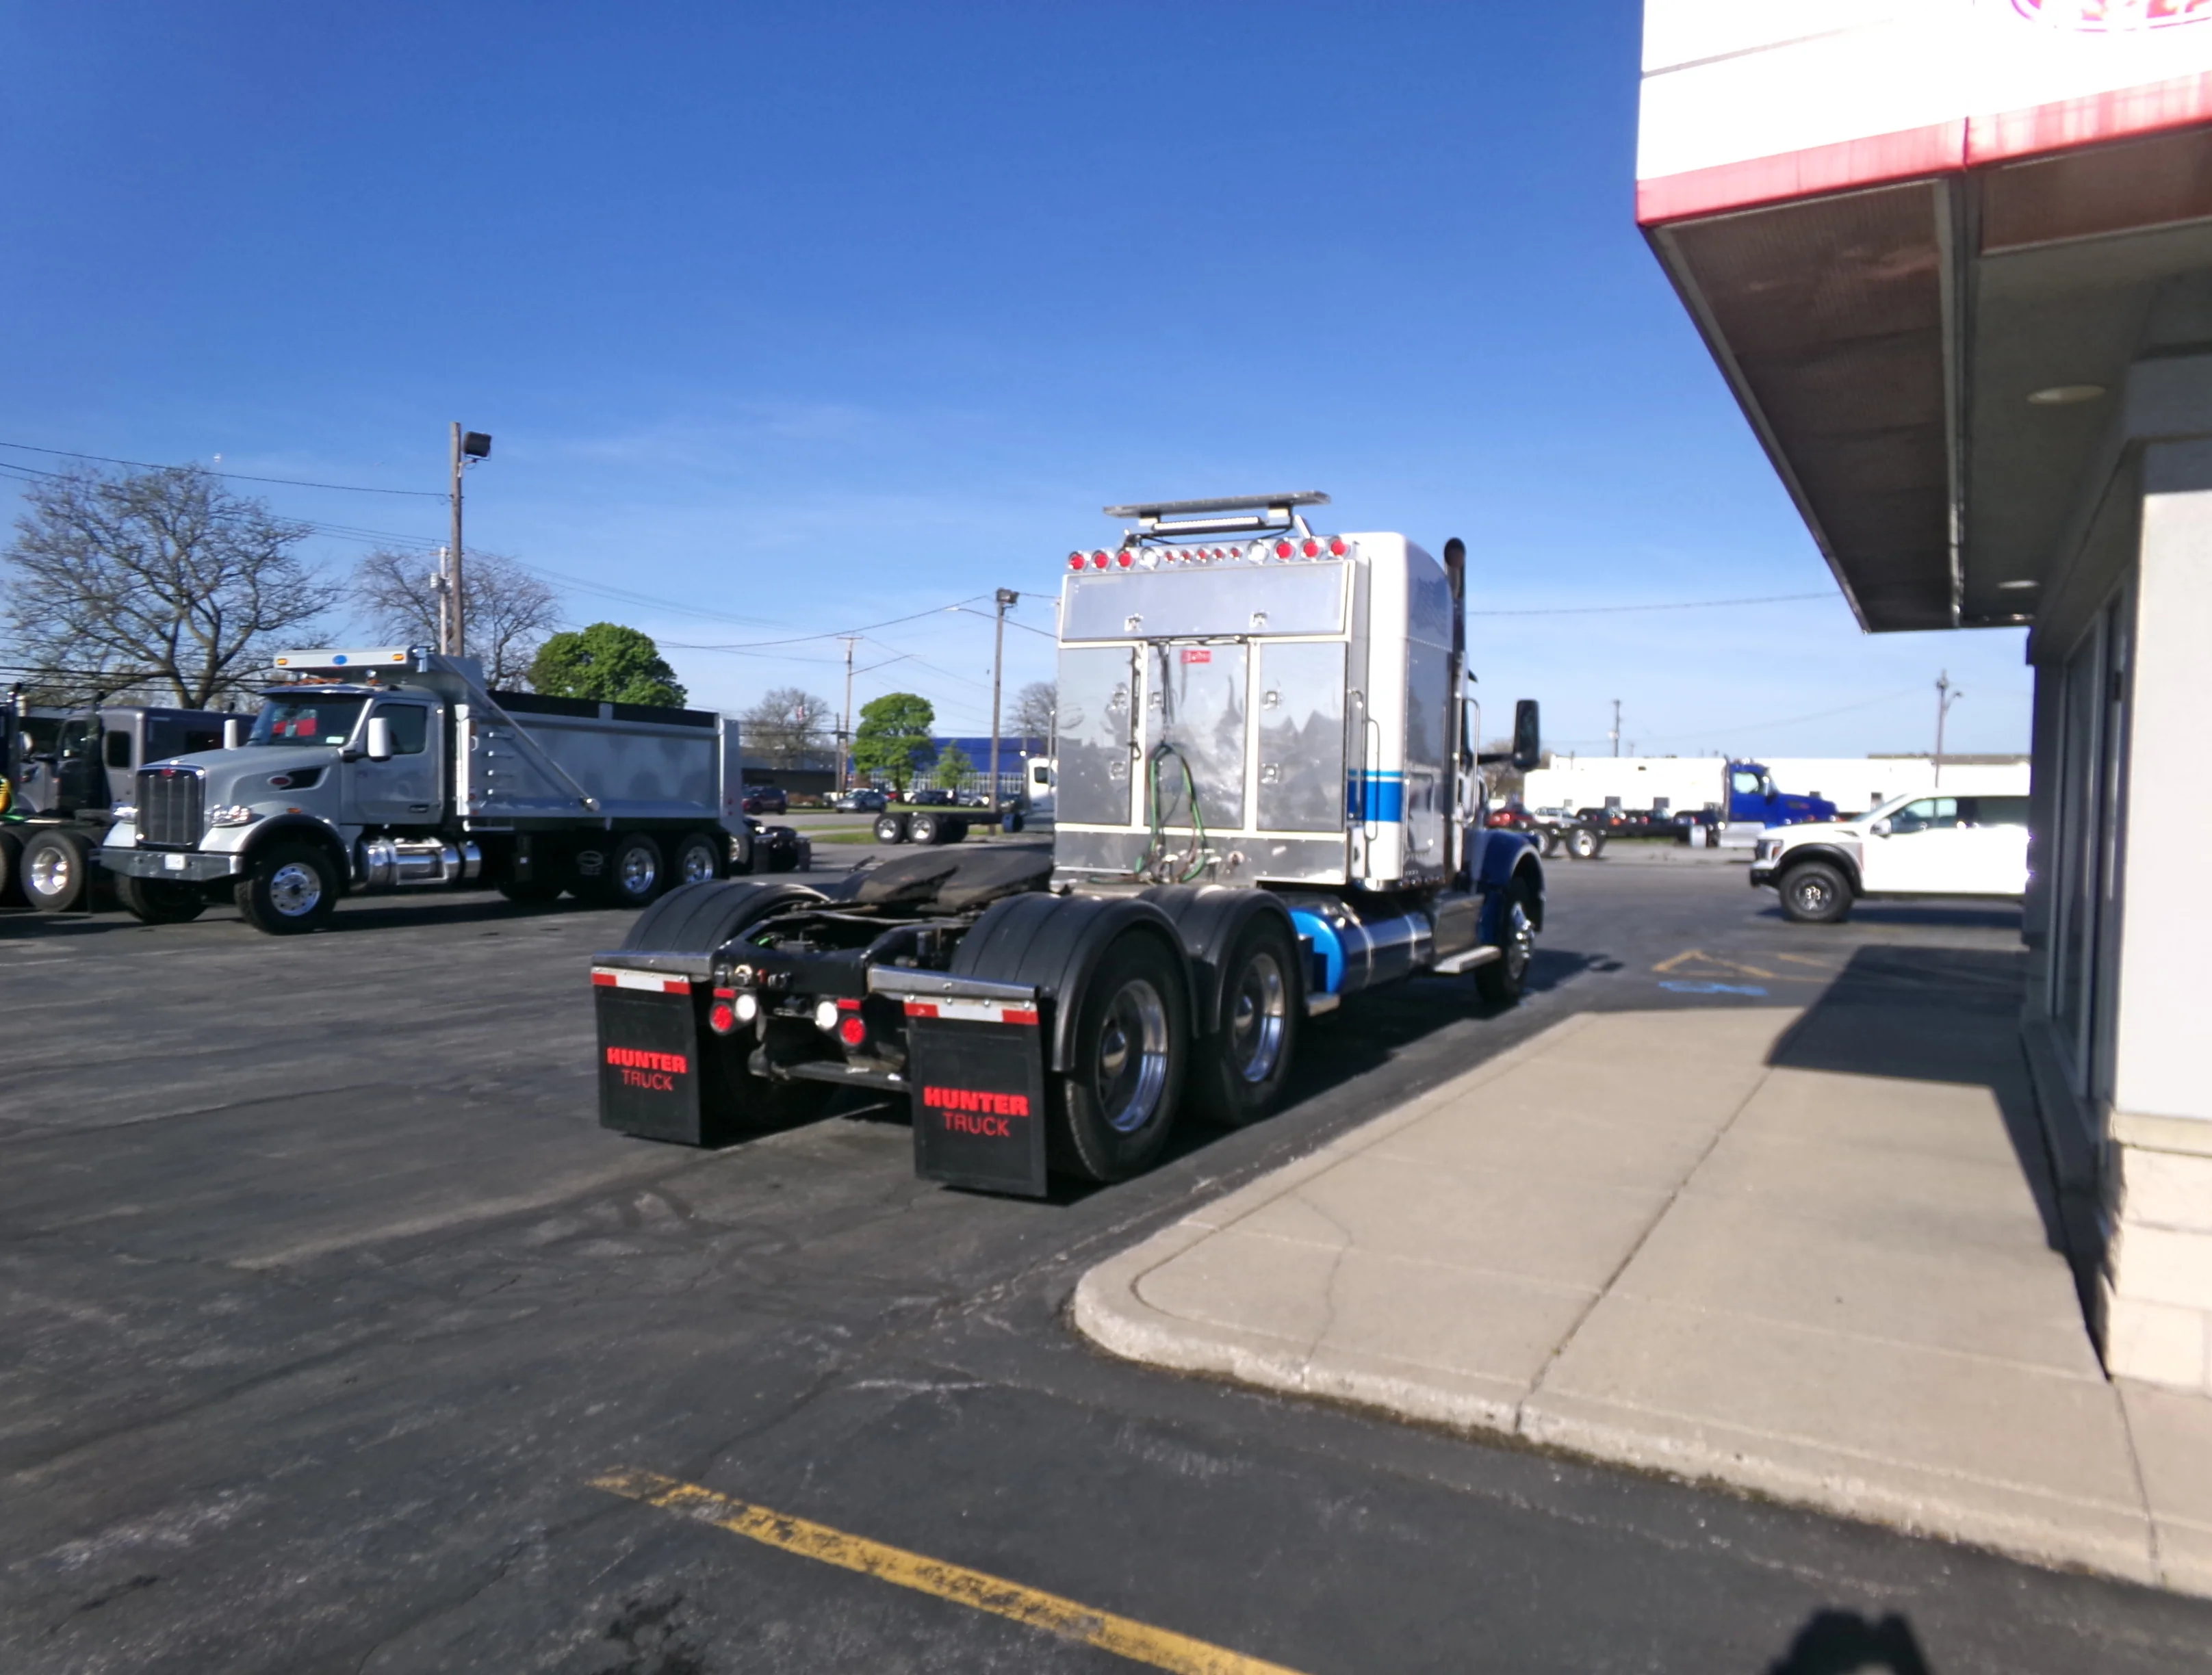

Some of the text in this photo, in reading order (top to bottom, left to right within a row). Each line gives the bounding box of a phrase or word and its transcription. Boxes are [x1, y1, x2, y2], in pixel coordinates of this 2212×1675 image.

[606, 1046, 687, 1074] HUNTER
[621, 1068, 674, 1091] TRUCK
[924, 1085, 1029, 1117] HUNTER
[942, 1111, 1011, 1137] TRUCK
